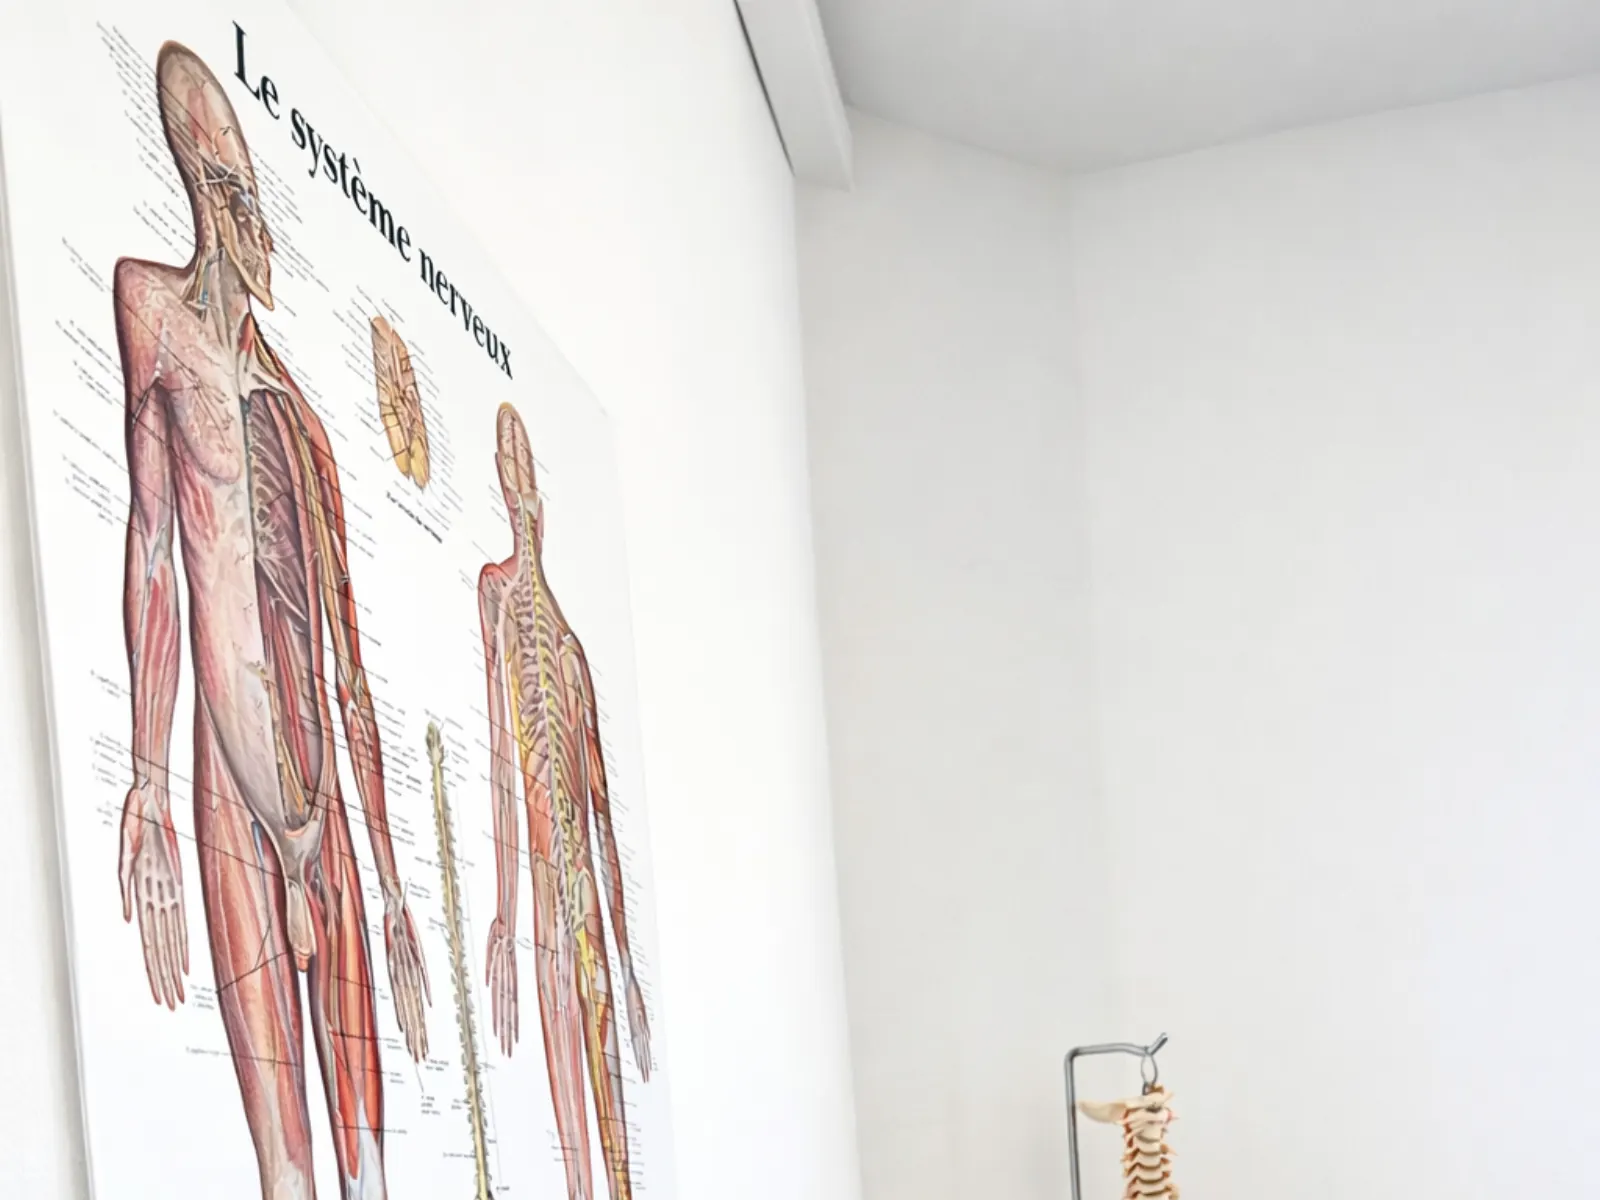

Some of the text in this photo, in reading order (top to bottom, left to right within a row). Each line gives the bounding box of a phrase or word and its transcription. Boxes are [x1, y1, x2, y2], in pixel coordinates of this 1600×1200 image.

[232, 20, 280, 120] Le
[290, 108, 411, 263] système
[418, 248, 513, 380] nerveux
